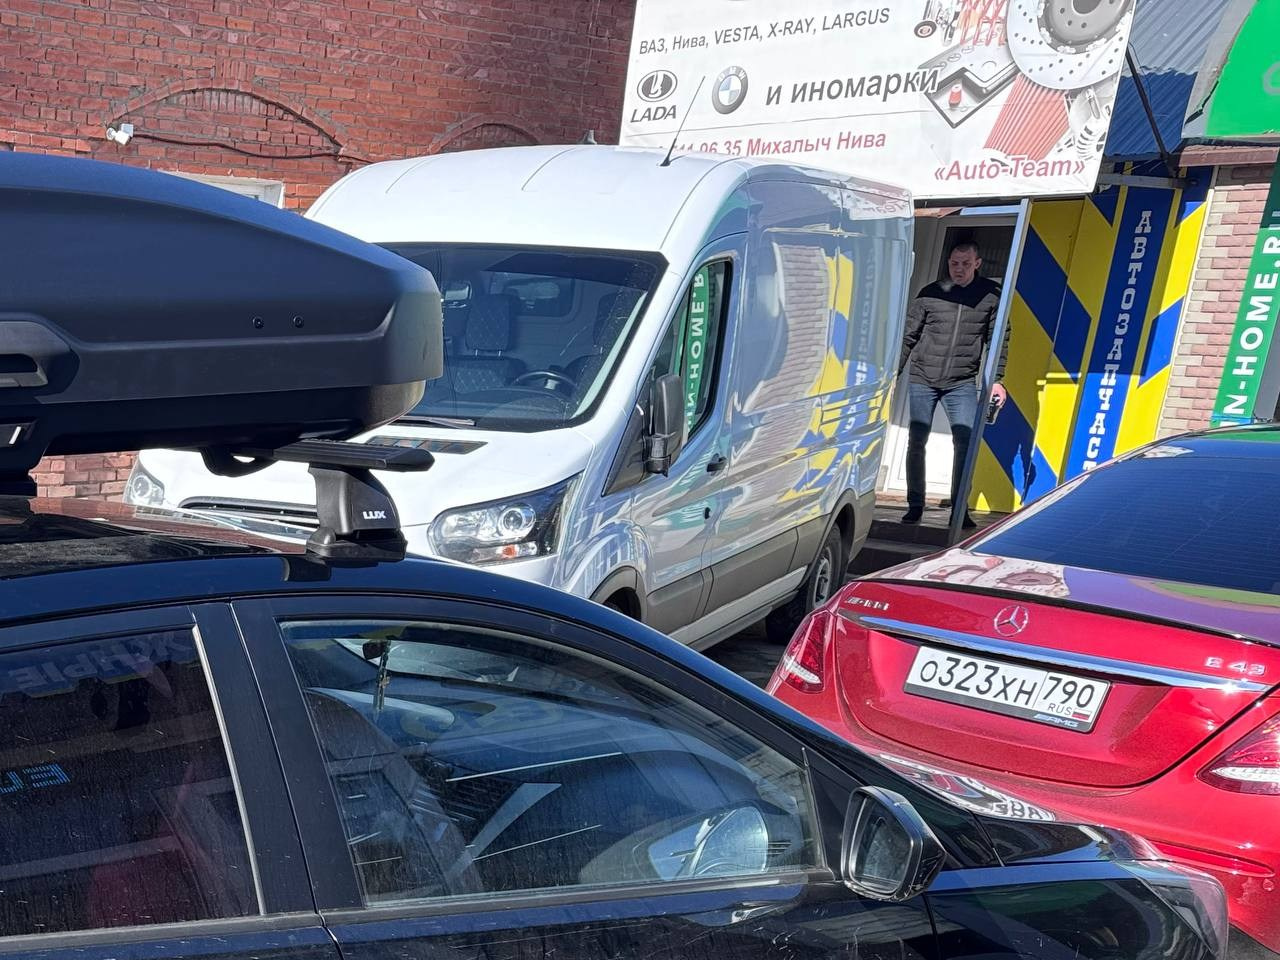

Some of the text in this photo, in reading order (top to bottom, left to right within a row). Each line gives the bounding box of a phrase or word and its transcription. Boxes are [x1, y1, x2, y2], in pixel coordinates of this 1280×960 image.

[639, 7, 890, 55] ВАЗ, Нива, VESTA, X-RAY, LARGUS
[766, 66, 941, 106] и иномарки
[630, 104, 677, 123] LADA
[746, 135, 831, 158] Михалыч
[836, 131, 887, 150] Нива
[934, 157, 1086, 182] «Auto-Team»
[362, 510, 387, 520] LUX
[1042, 676, 1096, 709] 790
[1047, 702, 1073, 716] RUS
